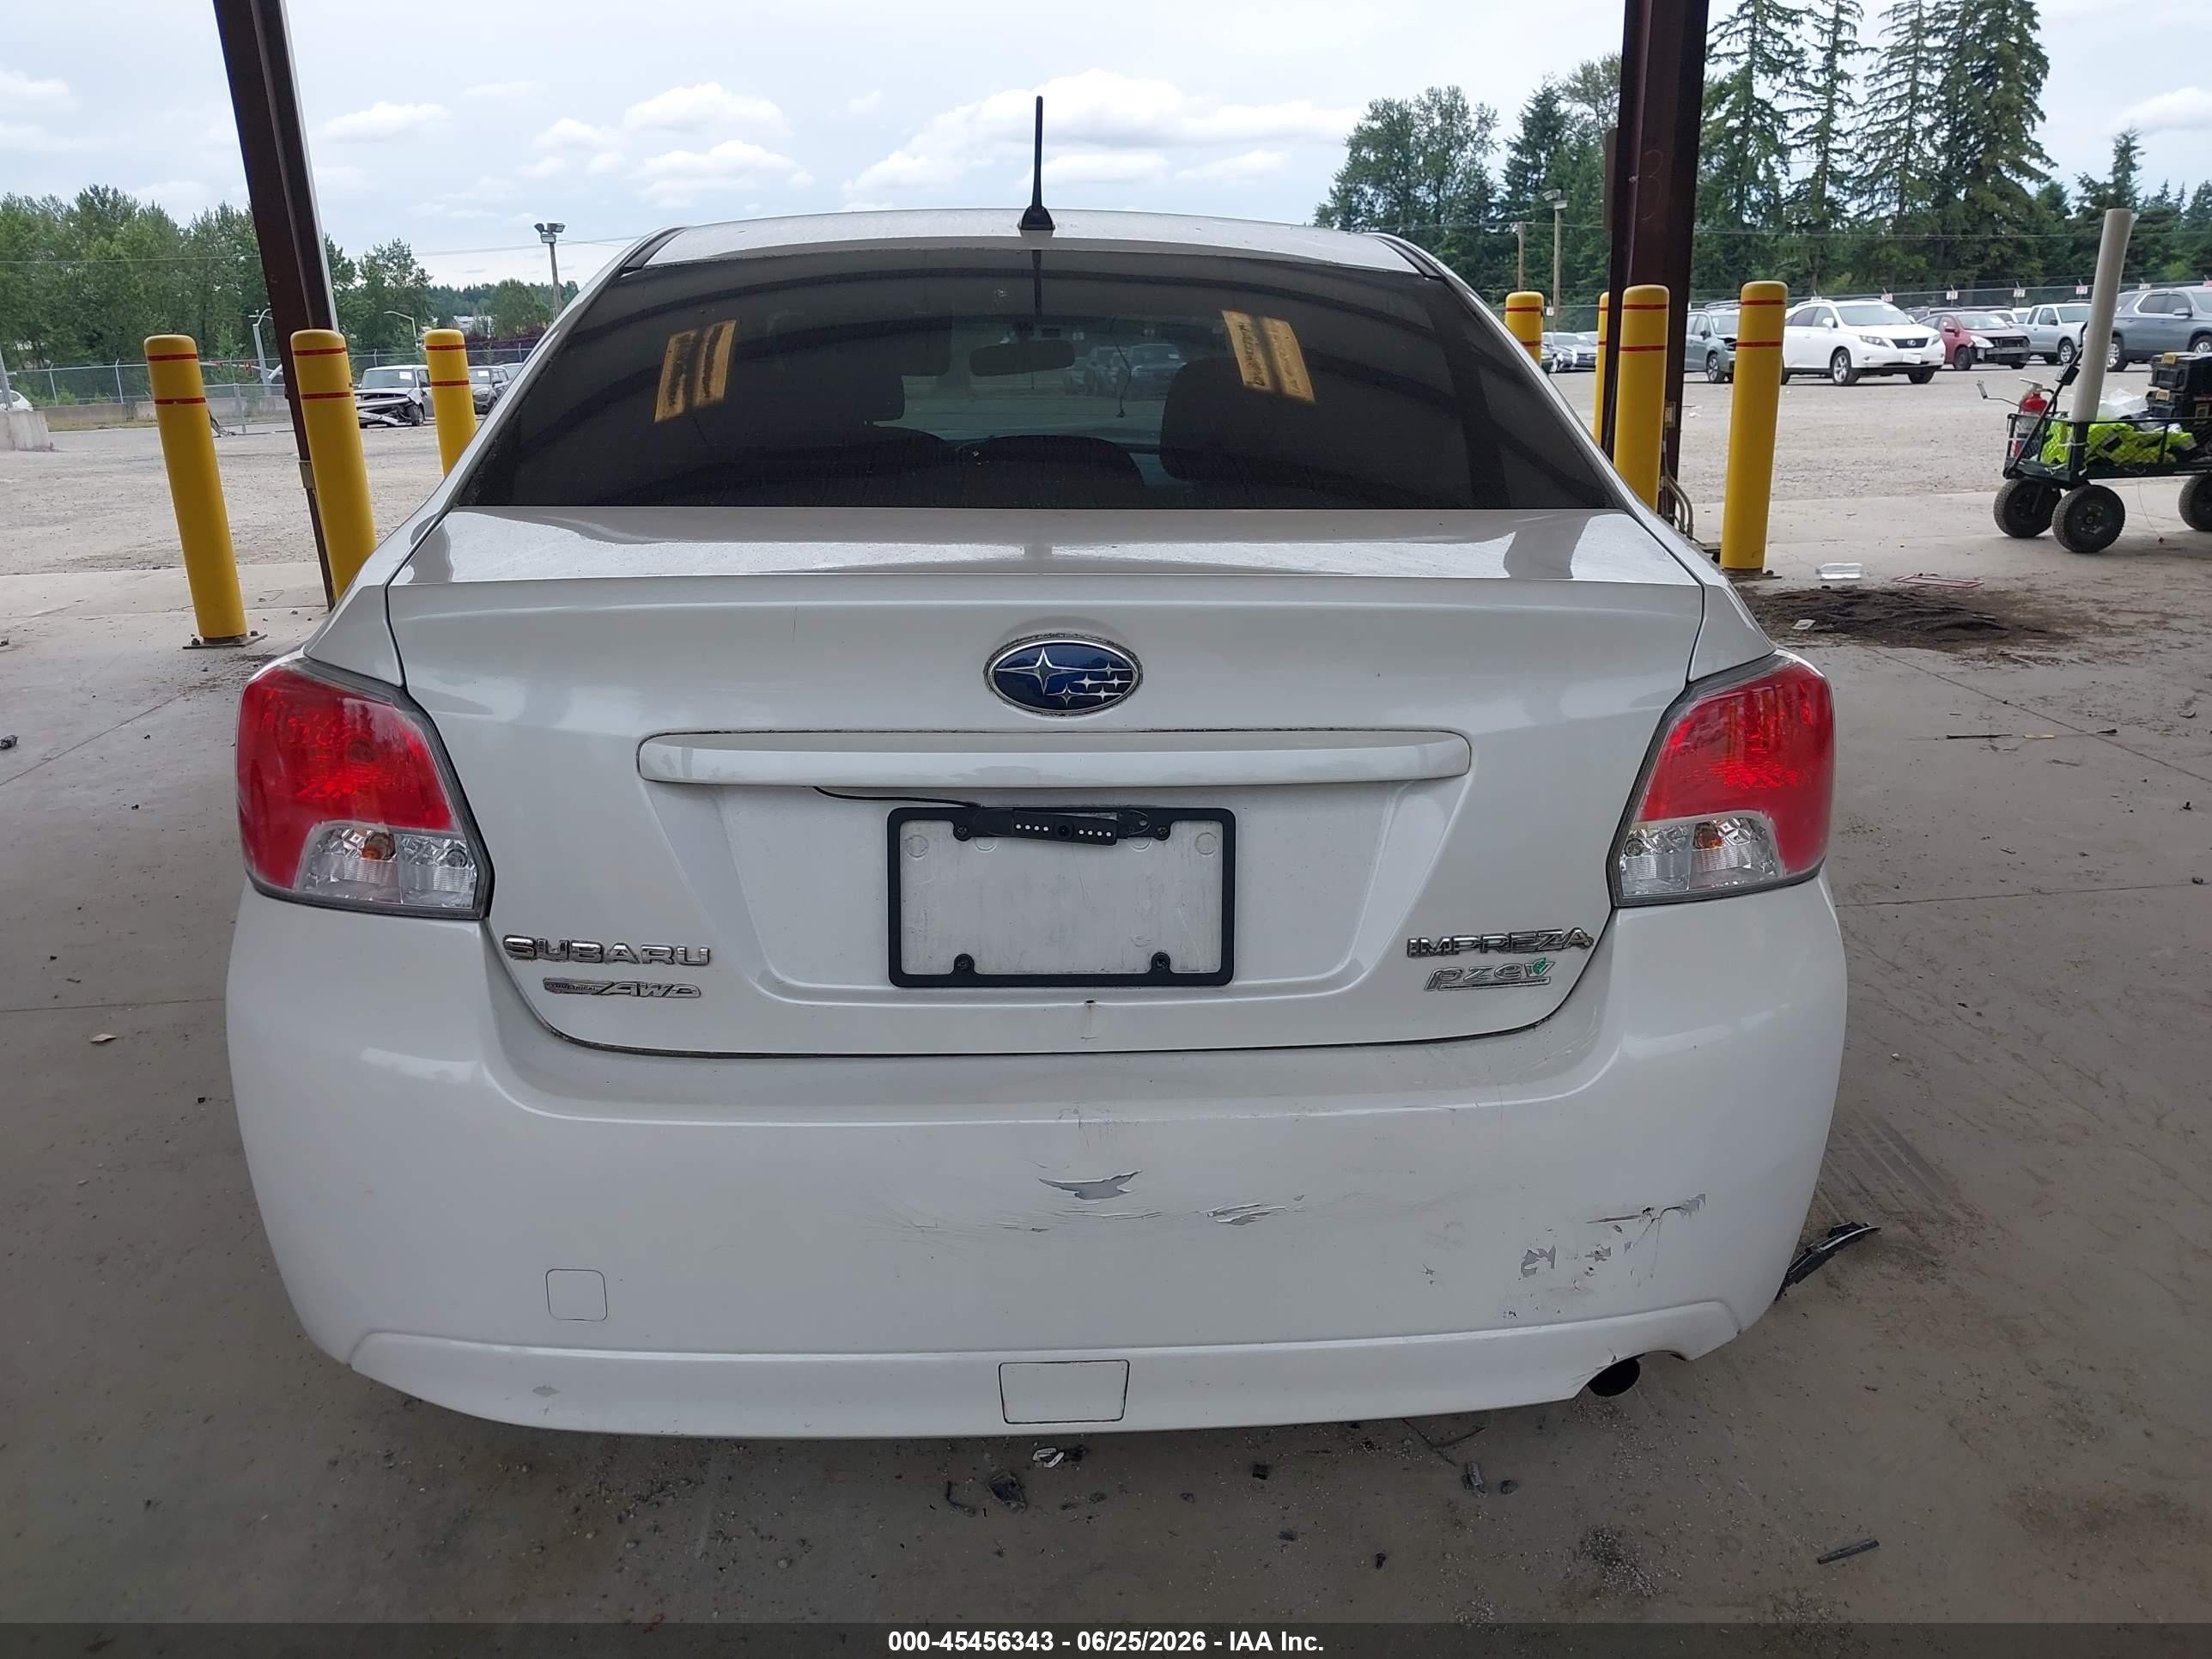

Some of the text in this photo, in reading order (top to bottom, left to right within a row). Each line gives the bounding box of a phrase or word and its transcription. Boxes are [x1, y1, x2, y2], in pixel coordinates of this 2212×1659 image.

[503, 933, 711, 966] SUBARU
[1407, 927, 1595, 957] IMPREZA
[601, 981, 702, 998] AWD
